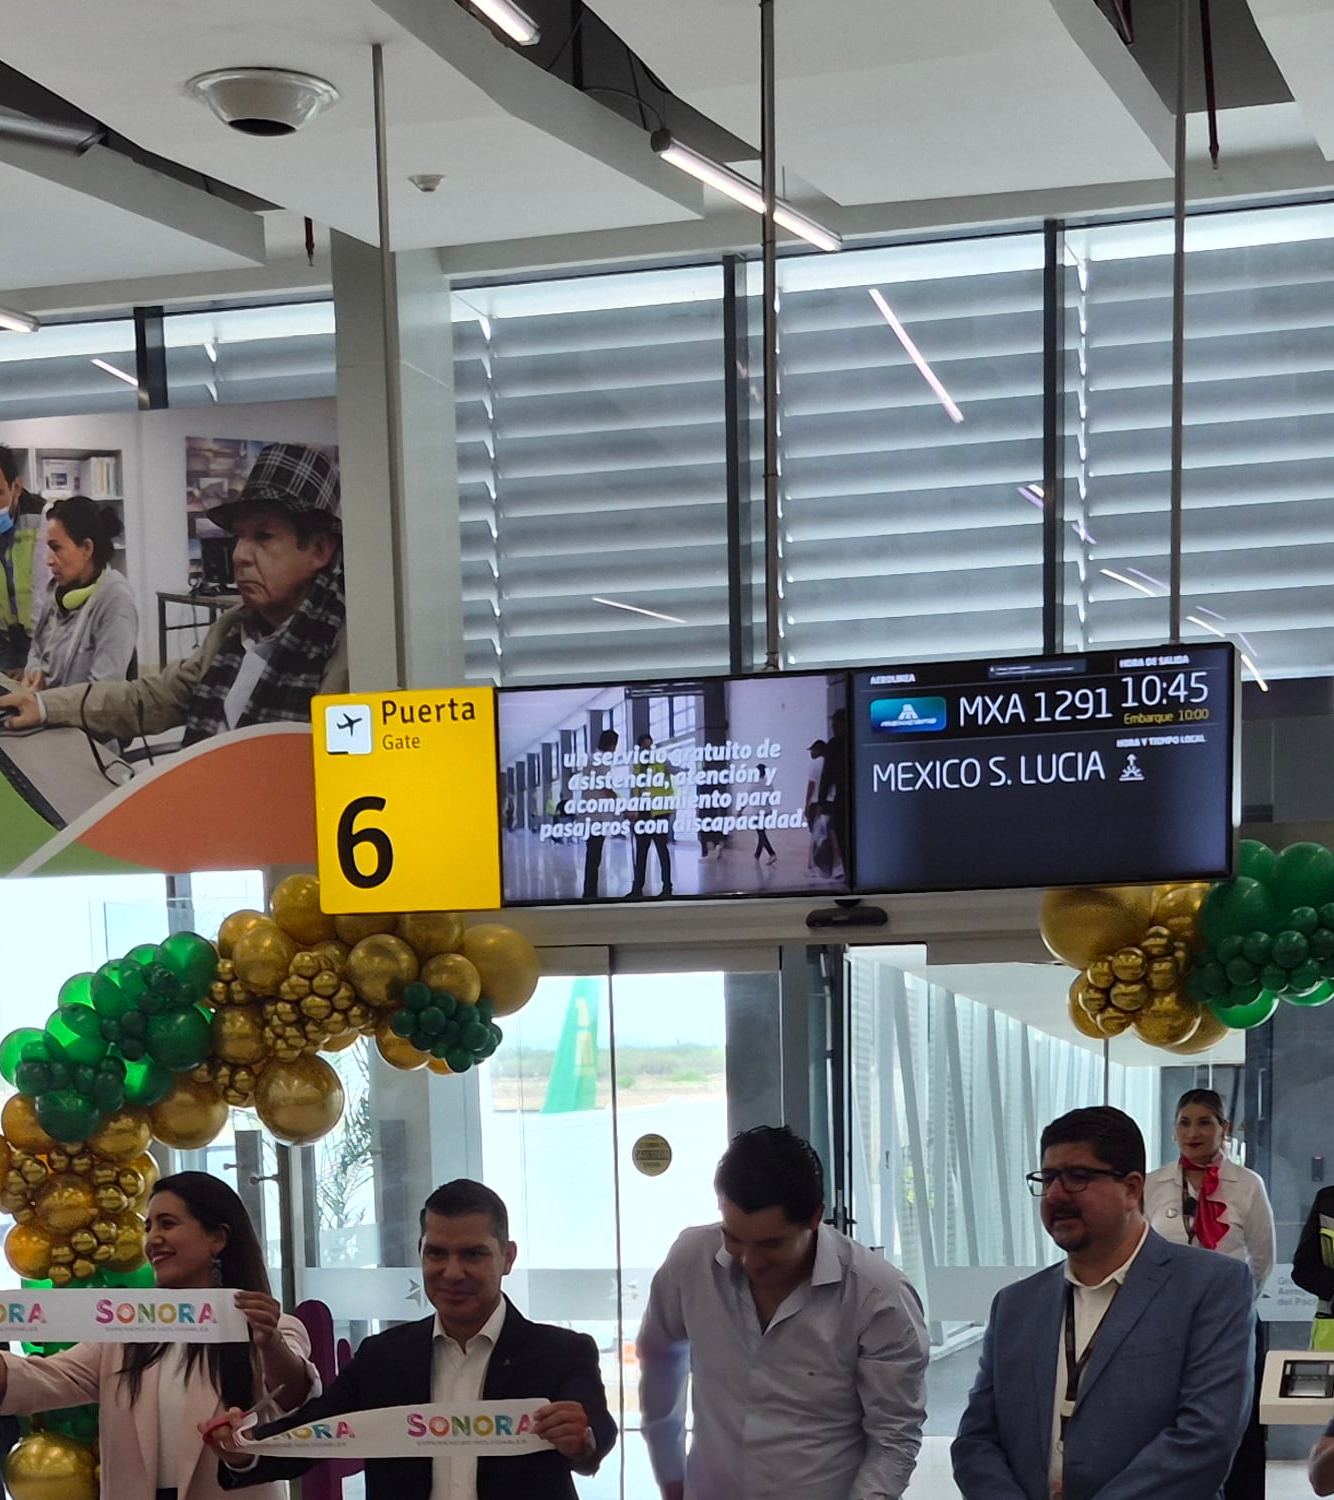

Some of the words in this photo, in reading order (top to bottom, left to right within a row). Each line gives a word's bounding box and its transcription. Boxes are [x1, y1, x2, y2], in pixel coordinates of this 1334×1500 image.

[382, 698, 476, 725] Puerta
[959, 692, 1027, 727] MXA
[1033, 687, 1114, 723] 1291
[1121, 671, 1210, 708] 10:45
[1123, 711, 1174, 725] Embarque
[1177, 708, 1210, 722] 10:00
[382, 734, 421, 751] Gate
[563, 750, 588, 768] un
[591, 745, 664, 767] servicio
[667, 741, 752, 767] gratuito
[755, 738, 781, 760] de
[568, 768, 670, 791] asistencia,
[674, 764, 760, 787] atención
[764, 767, 777, 786] y
[872, 757, 981, 793] MEXICO
[988, 755, 1012, 787] S.
[1020, 750, 1106, 786] LUCIA
[564, 790, 732, 816] acompañamiento
[736, 790, 782, 812] para
[539, 819, 631, 842] pasajeros
[634, 818, 669, 835] con
[673, 808, 809, 836] discapacidad.
[336, 795, 395, 889] 6
[95, 1298, 217, 1324] SONORA
[407, 1412, 534, 1438] SONORA
